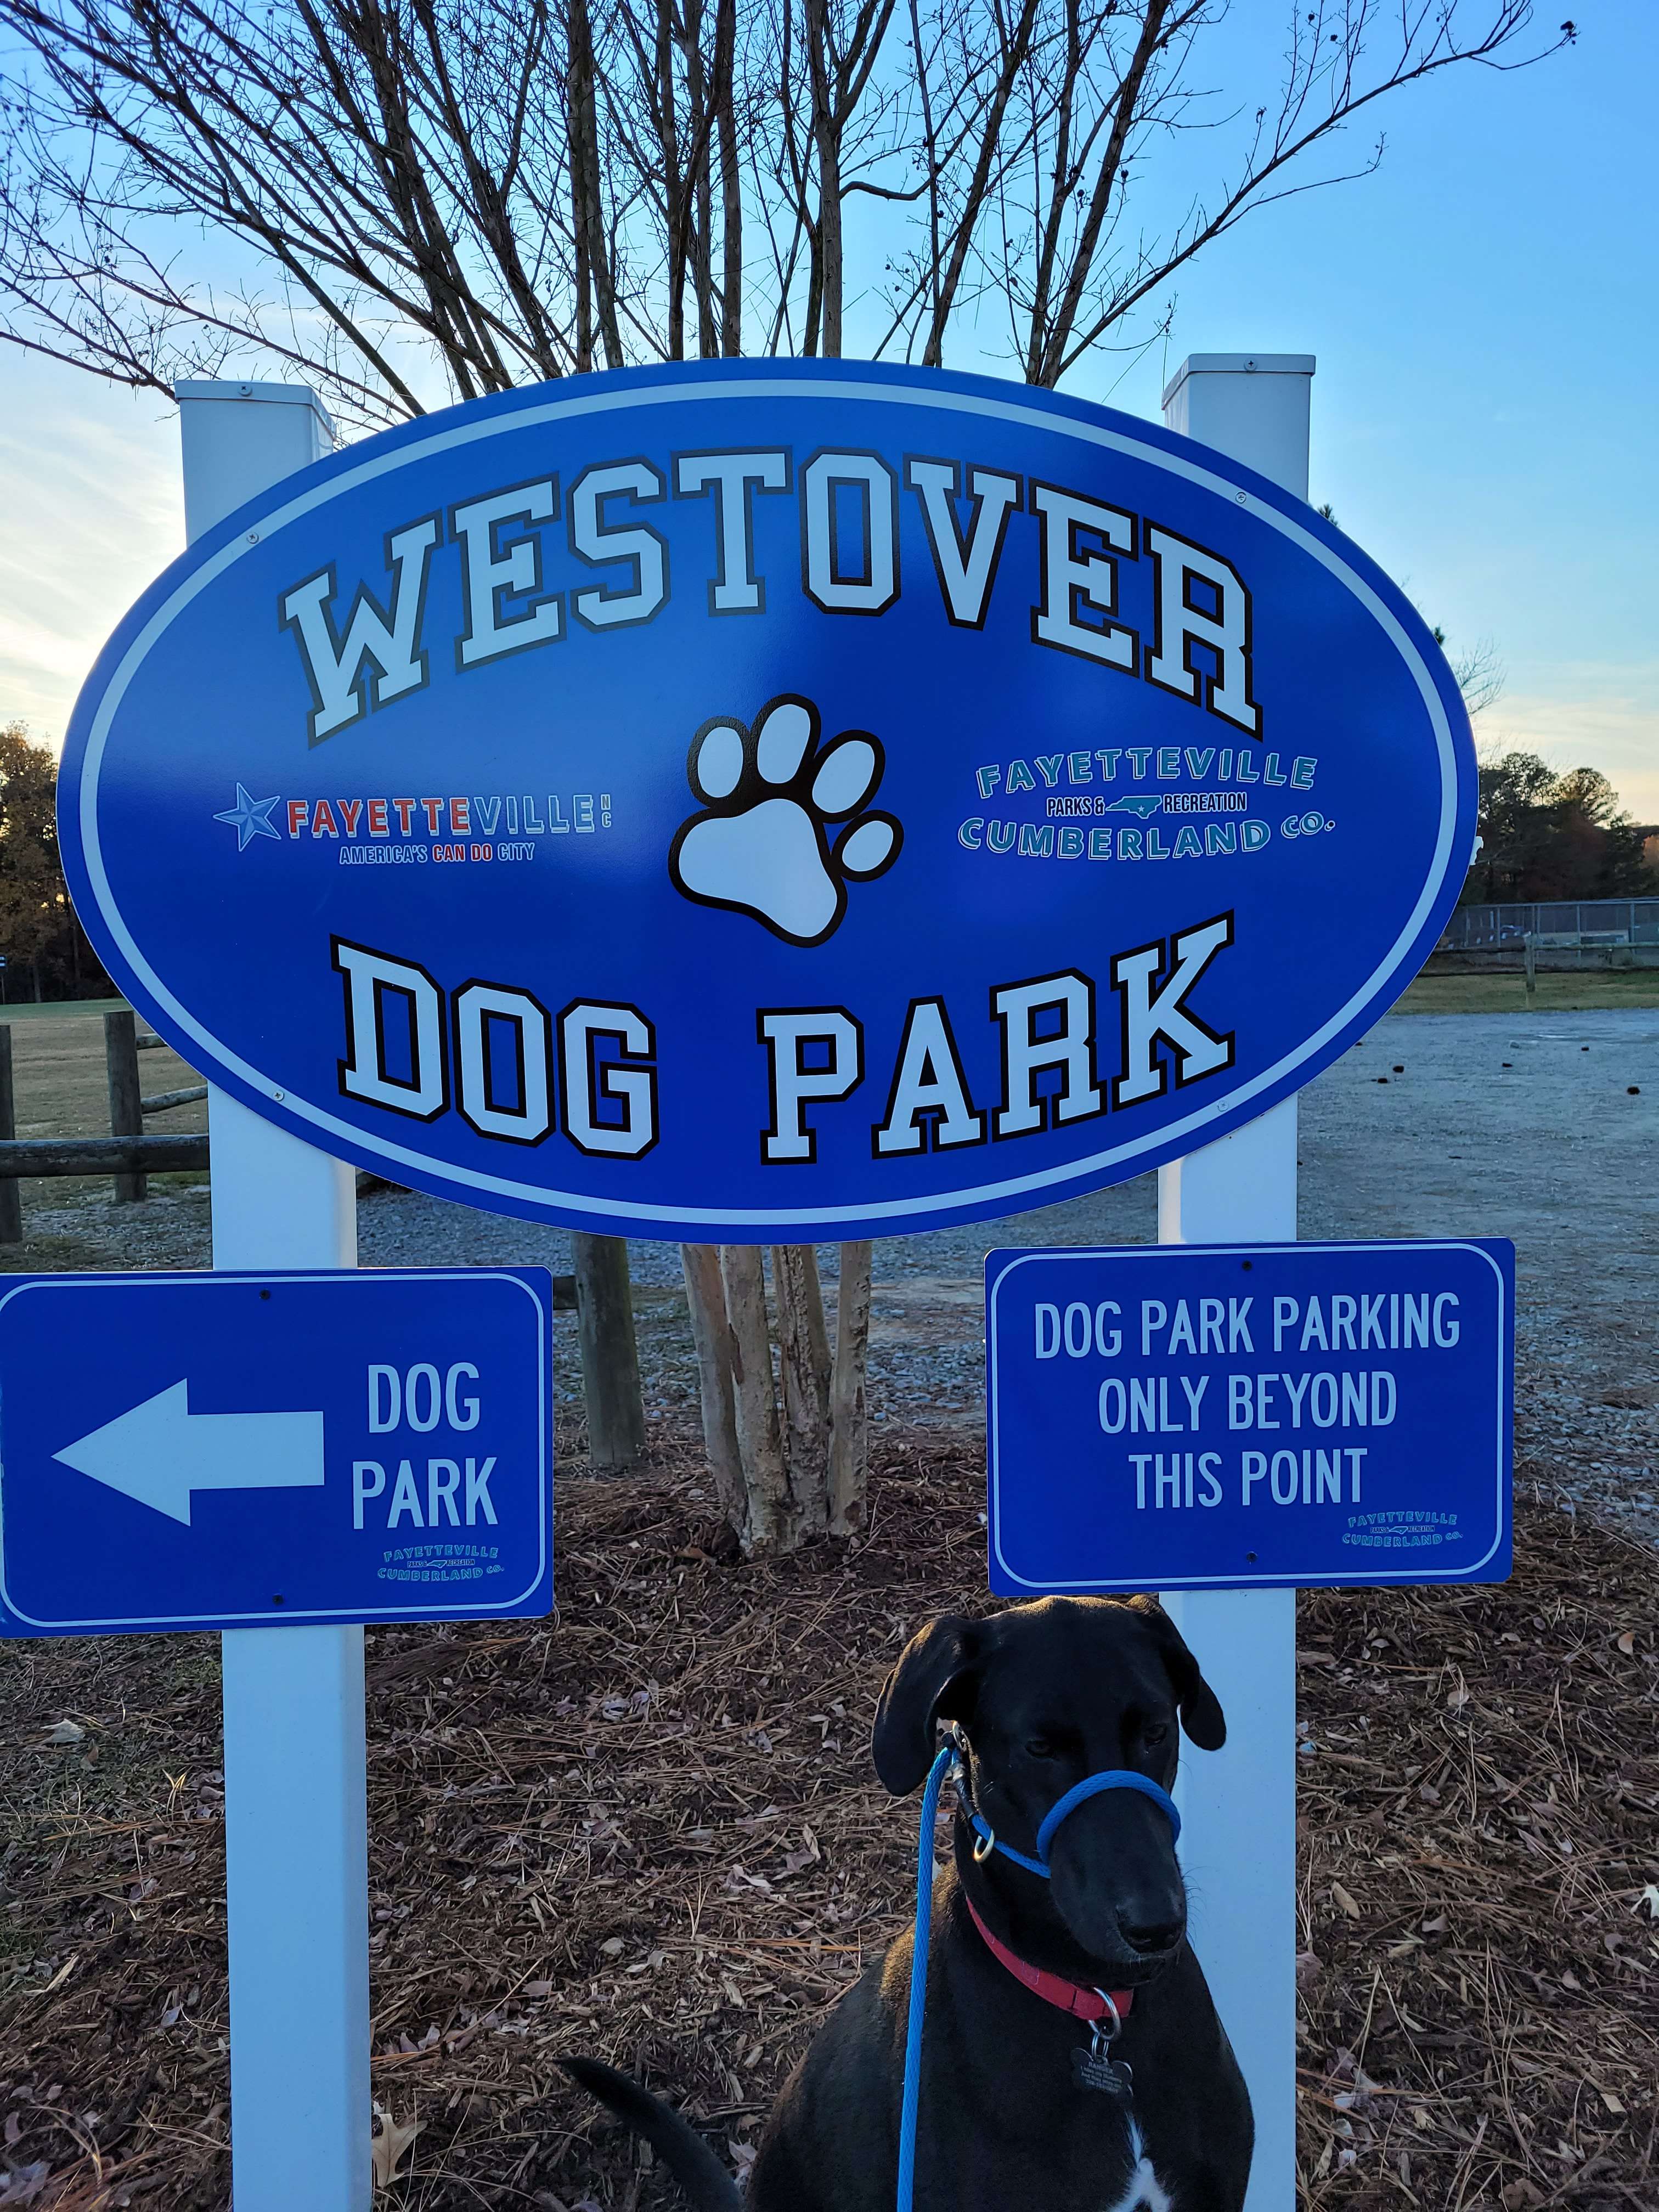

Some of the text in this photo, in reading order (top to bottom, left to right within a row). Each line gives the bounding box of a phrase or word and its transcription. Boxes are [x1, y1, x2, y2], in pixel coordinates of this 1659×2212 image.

[278, 447, 1264, 746] WESTOVER
[976, 747, 1318, 798] FAYETTEVILLE
[286, 794, 595, 839] FAYETTEVILLE
[1046, 792, 1248, 817] PARKS & RECREATION
[339, 842, 535, 865] AMERICA'S CAN DO CITY
[957, 811, 1336, 860] CUMBERLAND CO.
[329, 910, 1235, 1165] DOG PARK
[1035, 1291, 1460, 1359] DOG PARK PARKING
[368, 1362, 480, 1434] DOG
[1098, 1370, 1398, 1434] ONLY BEYOND
[353, 1457, 499, 1530] PARK
[1128, 1448, 1368, 1509] THIS POINT
[1342, 1533, 1443, 1547] CUMBERLAND
[1347, 1511, 1458, 1528] FAYETTEVILLE
[377, 1568, 483, 1581] CUMBERLAND
[383, 1545, 499, 1562] FAYETTEVILLE
